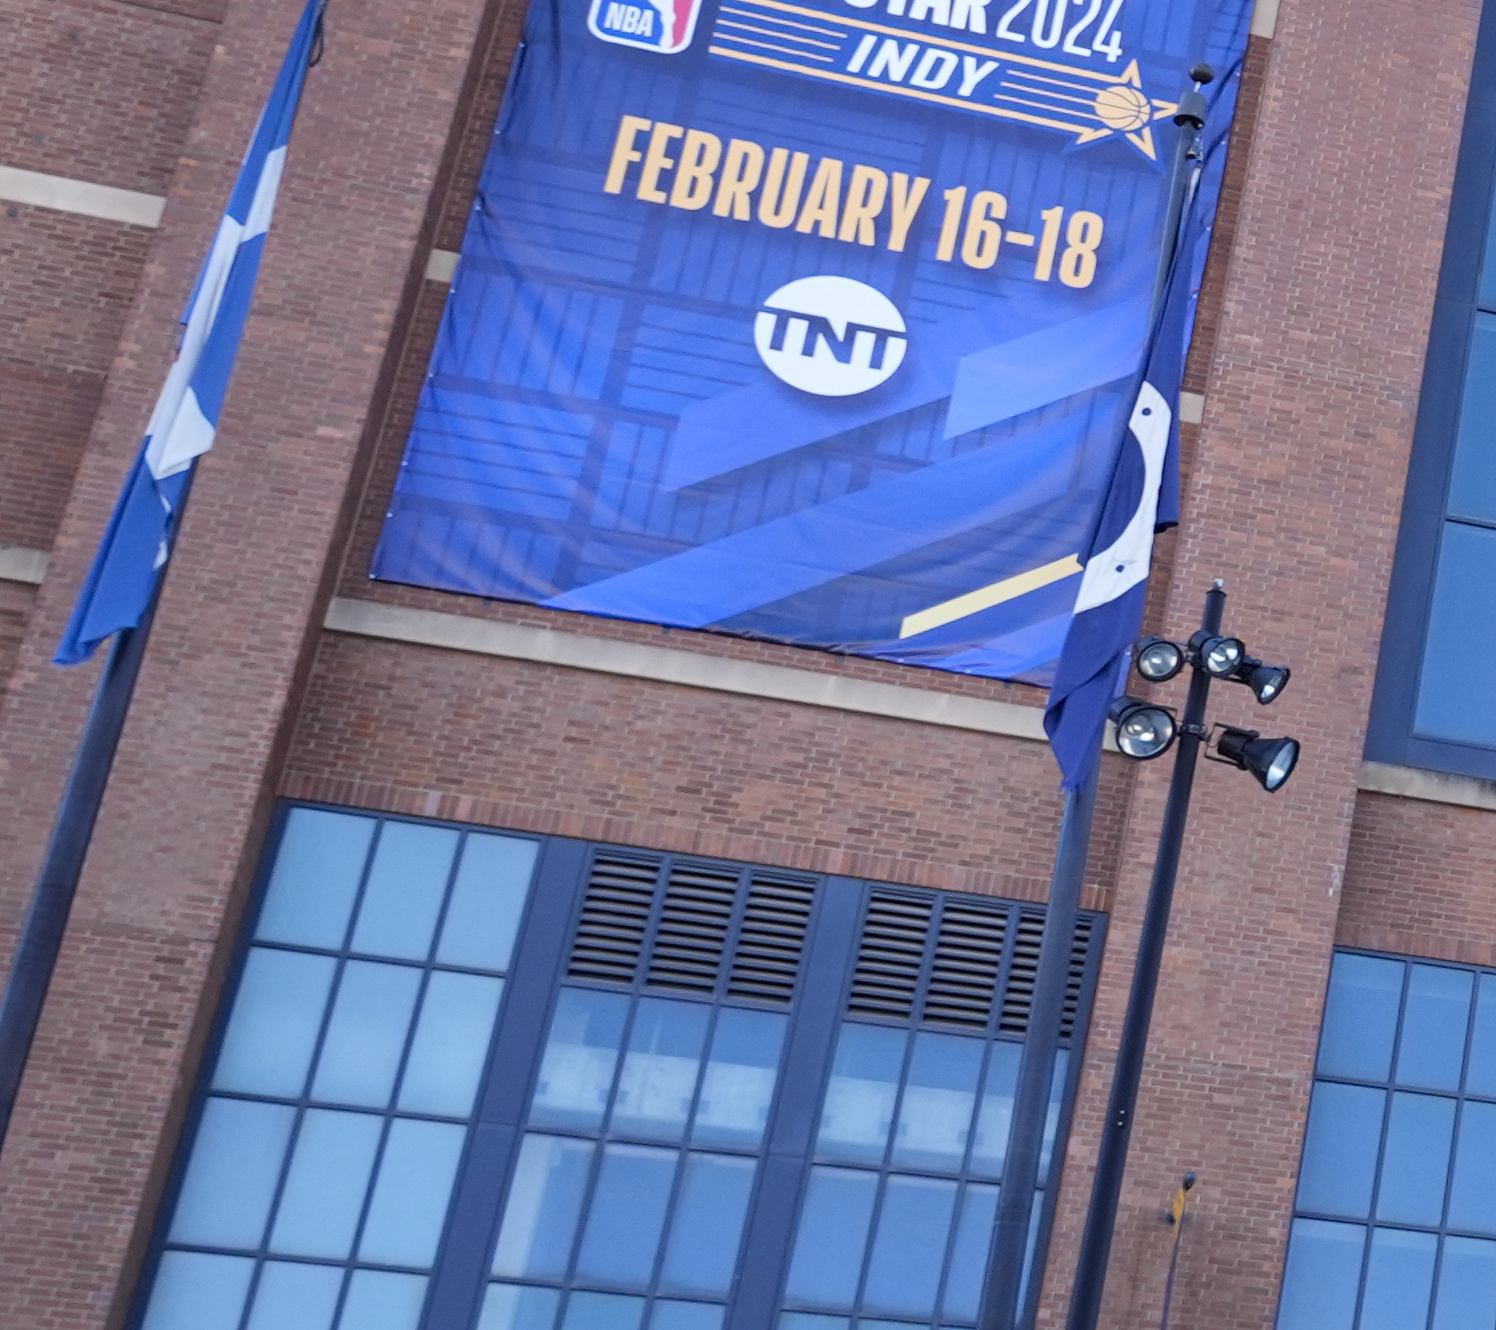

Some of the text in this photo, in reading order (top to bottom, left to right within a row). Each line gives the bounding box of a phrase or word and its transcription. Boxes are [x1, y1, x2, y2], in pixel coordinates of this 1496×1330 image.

[603, 2, 655, 38] NBA
[846, 34, 999, 97] INDY
[603, 114, 1104, 289] FEBRUARY 16-18
